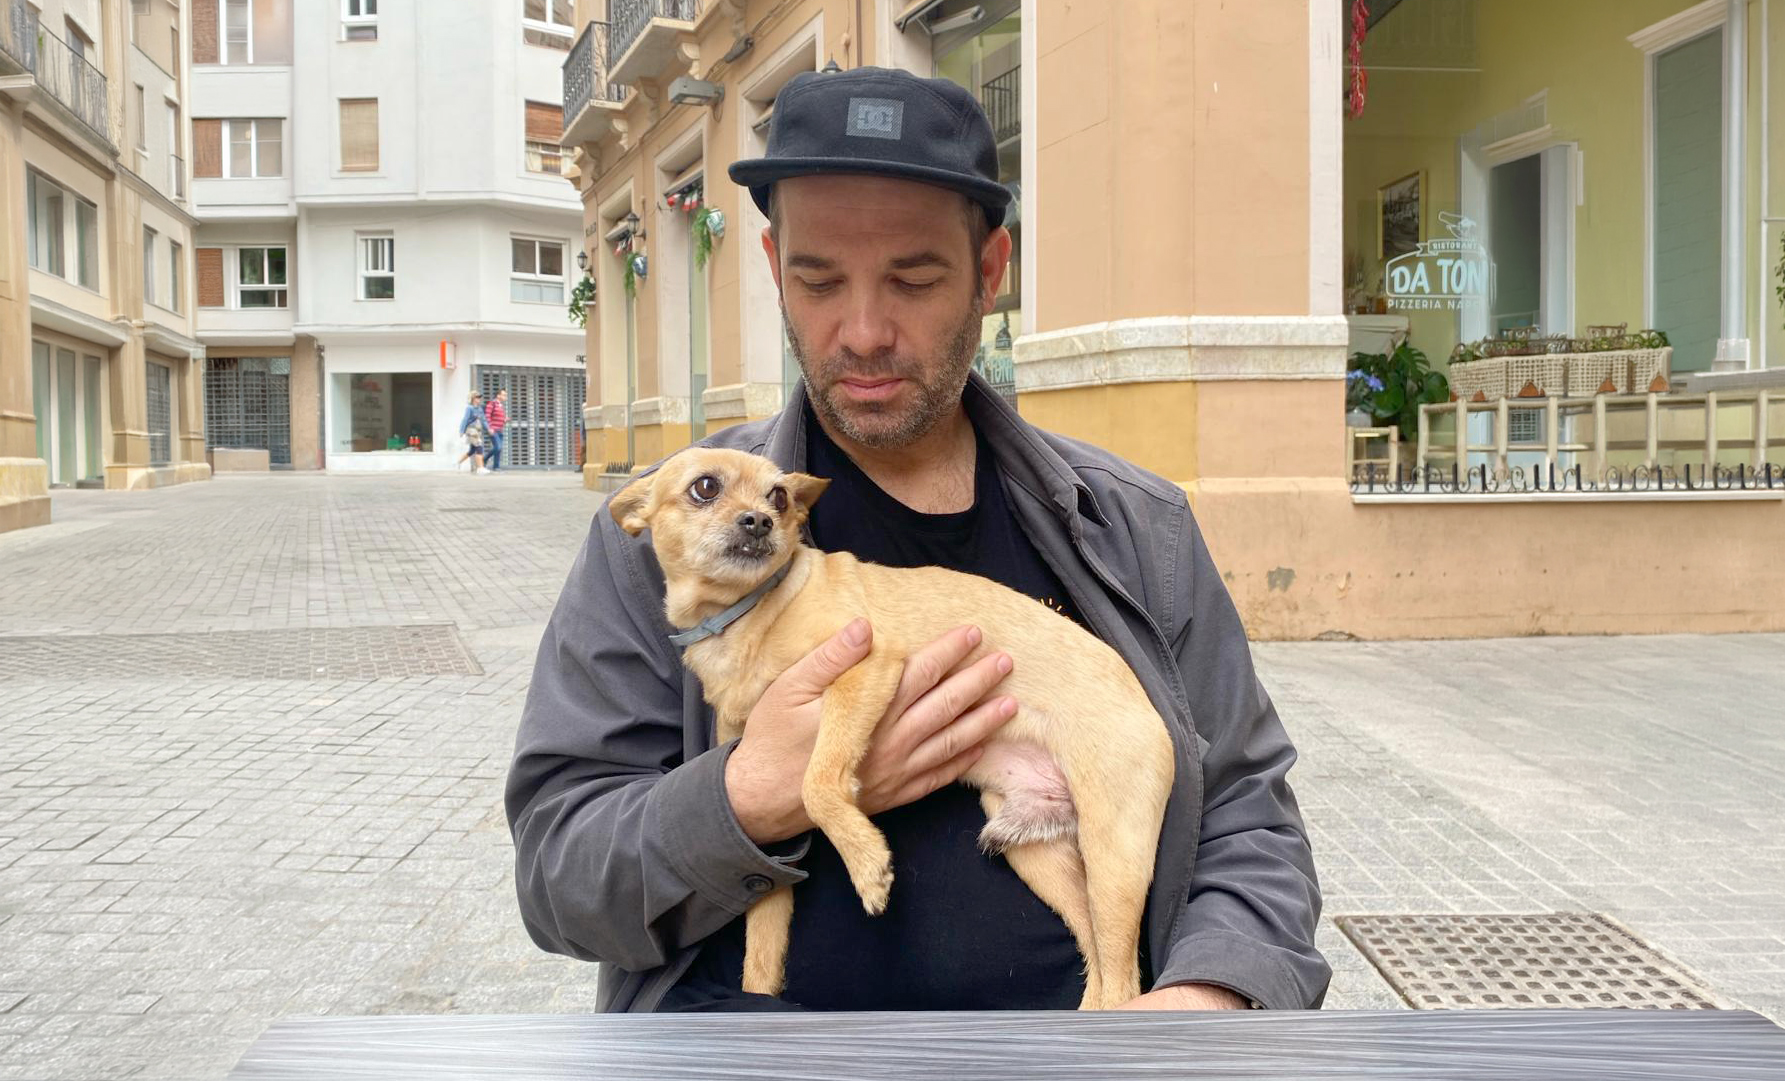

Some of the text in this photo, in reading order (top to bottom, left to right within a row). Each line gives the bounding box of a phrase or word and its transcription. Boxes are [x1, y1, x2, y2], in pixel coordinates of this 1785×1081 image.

[1432, 241, 1479, 250] RISTORANT
[1391, 262, 1430, 294] DA
[1388, 300, 1441, 310] PIZZERIA
